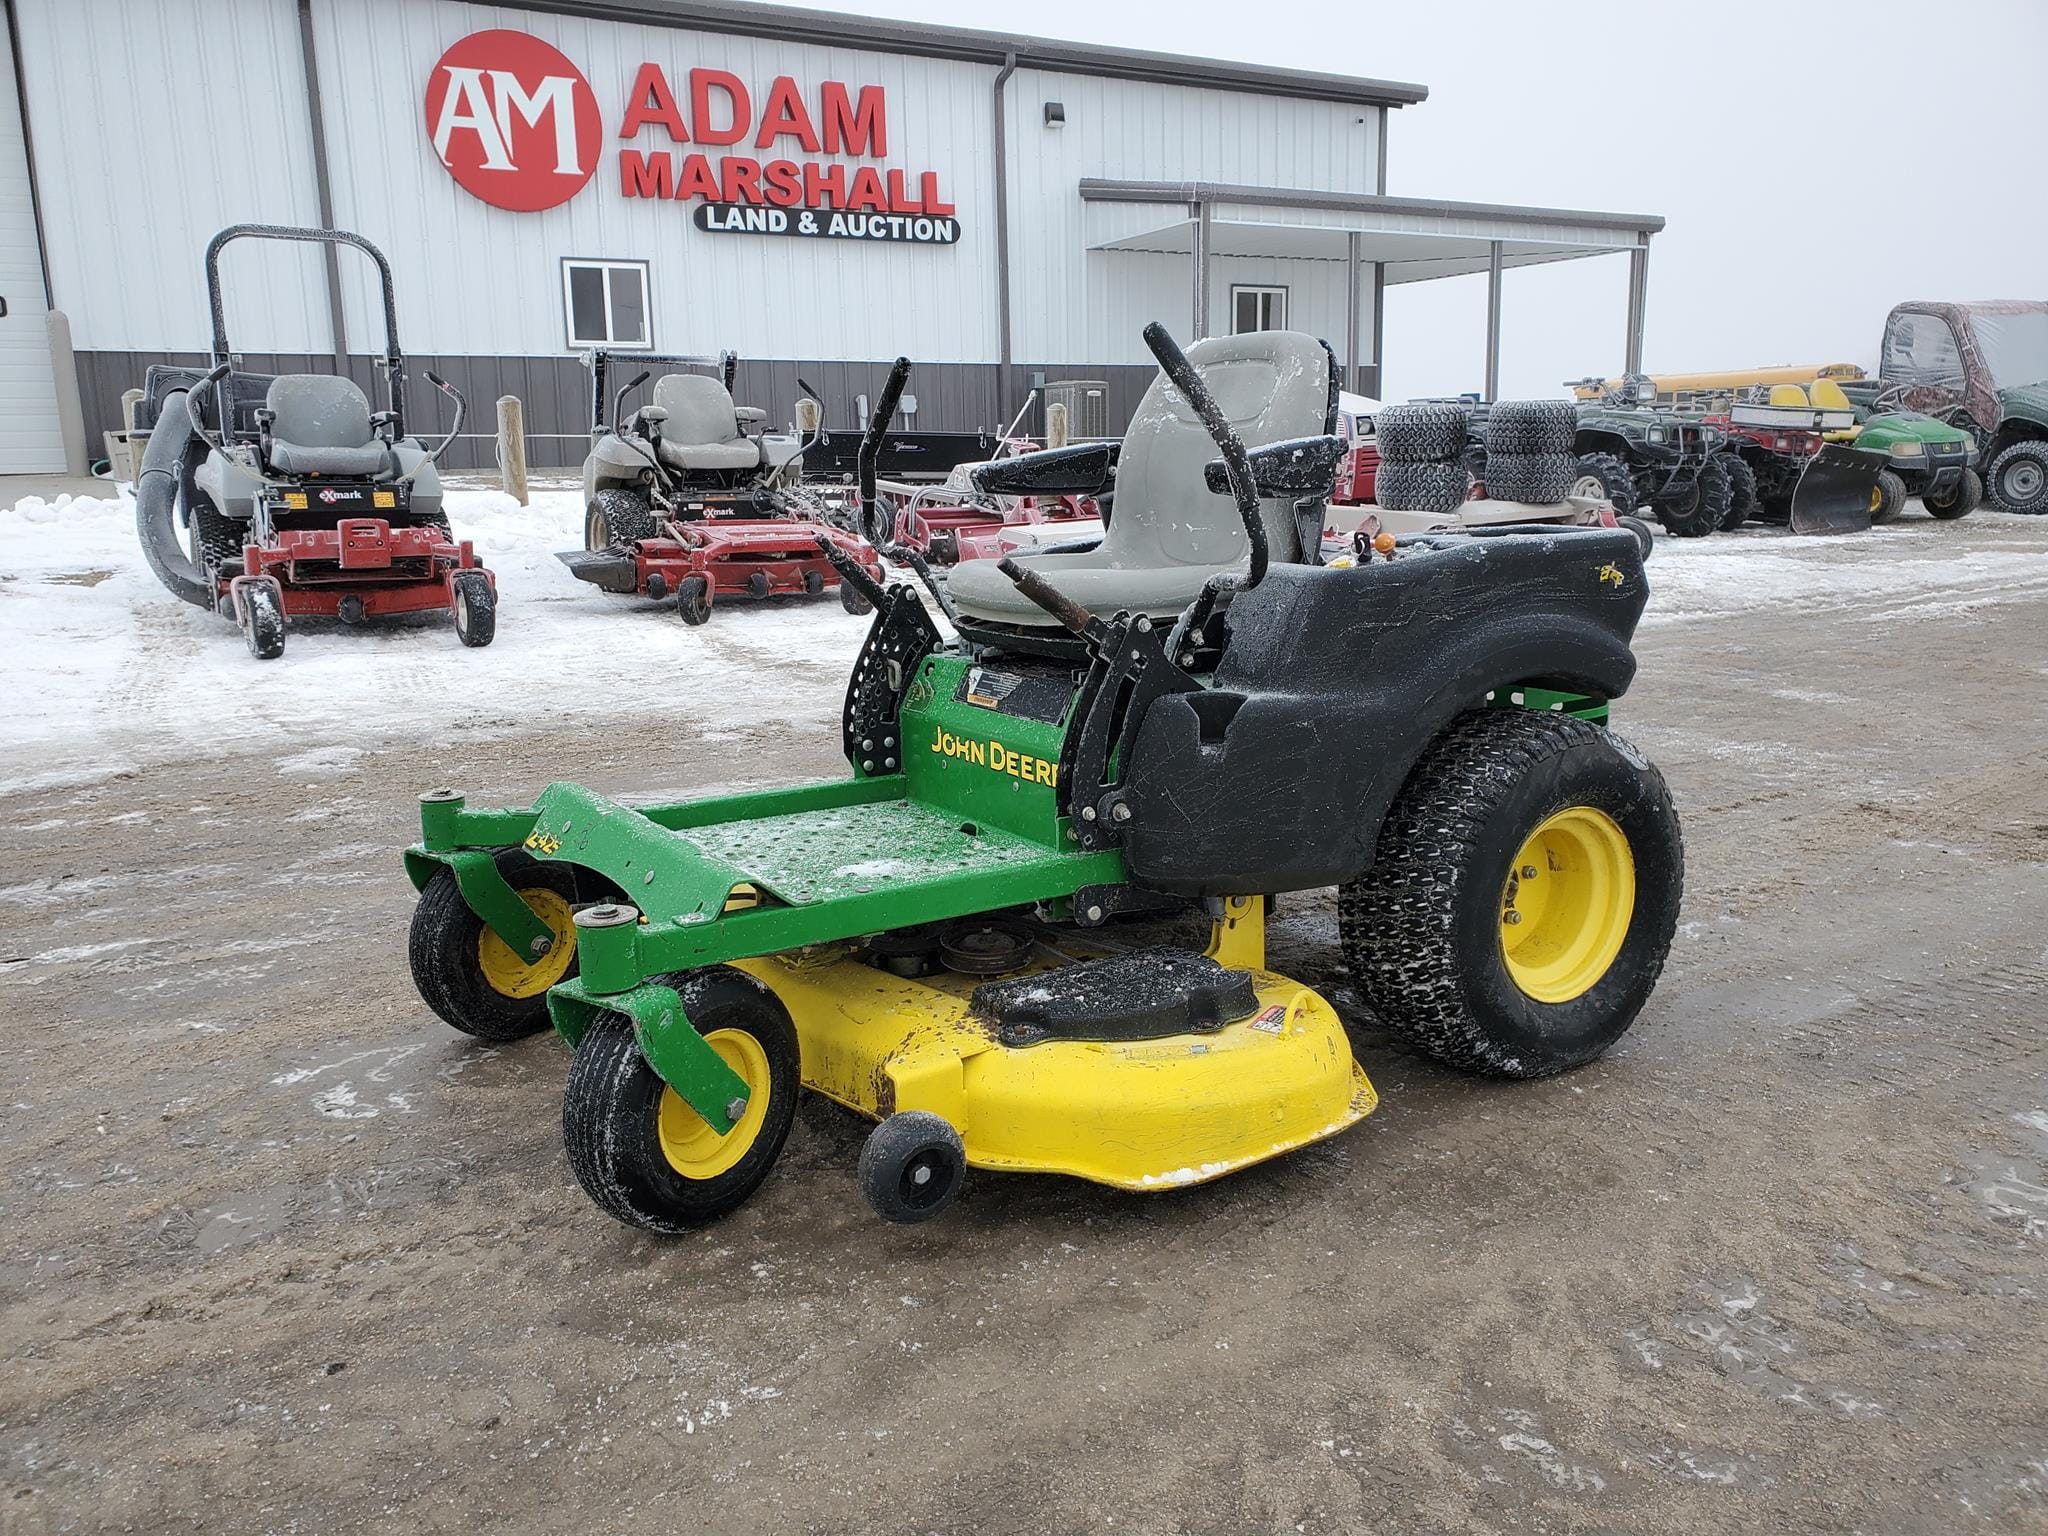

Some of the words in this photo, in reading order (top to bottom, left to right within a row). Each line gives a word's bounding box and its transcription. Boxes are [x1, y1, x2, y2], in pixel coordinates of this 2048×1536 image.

[433, 65, 584, 175] AM
[619, 62, 888, 158] ADAM
[619, 149, 956, 216] MARSHALL
[706, 206, 788, 233] LAND
[798, 211, 819, 235] &
[828, 214, 953, 242] AUCTION
[931, 725, 985, 766] JOHN
